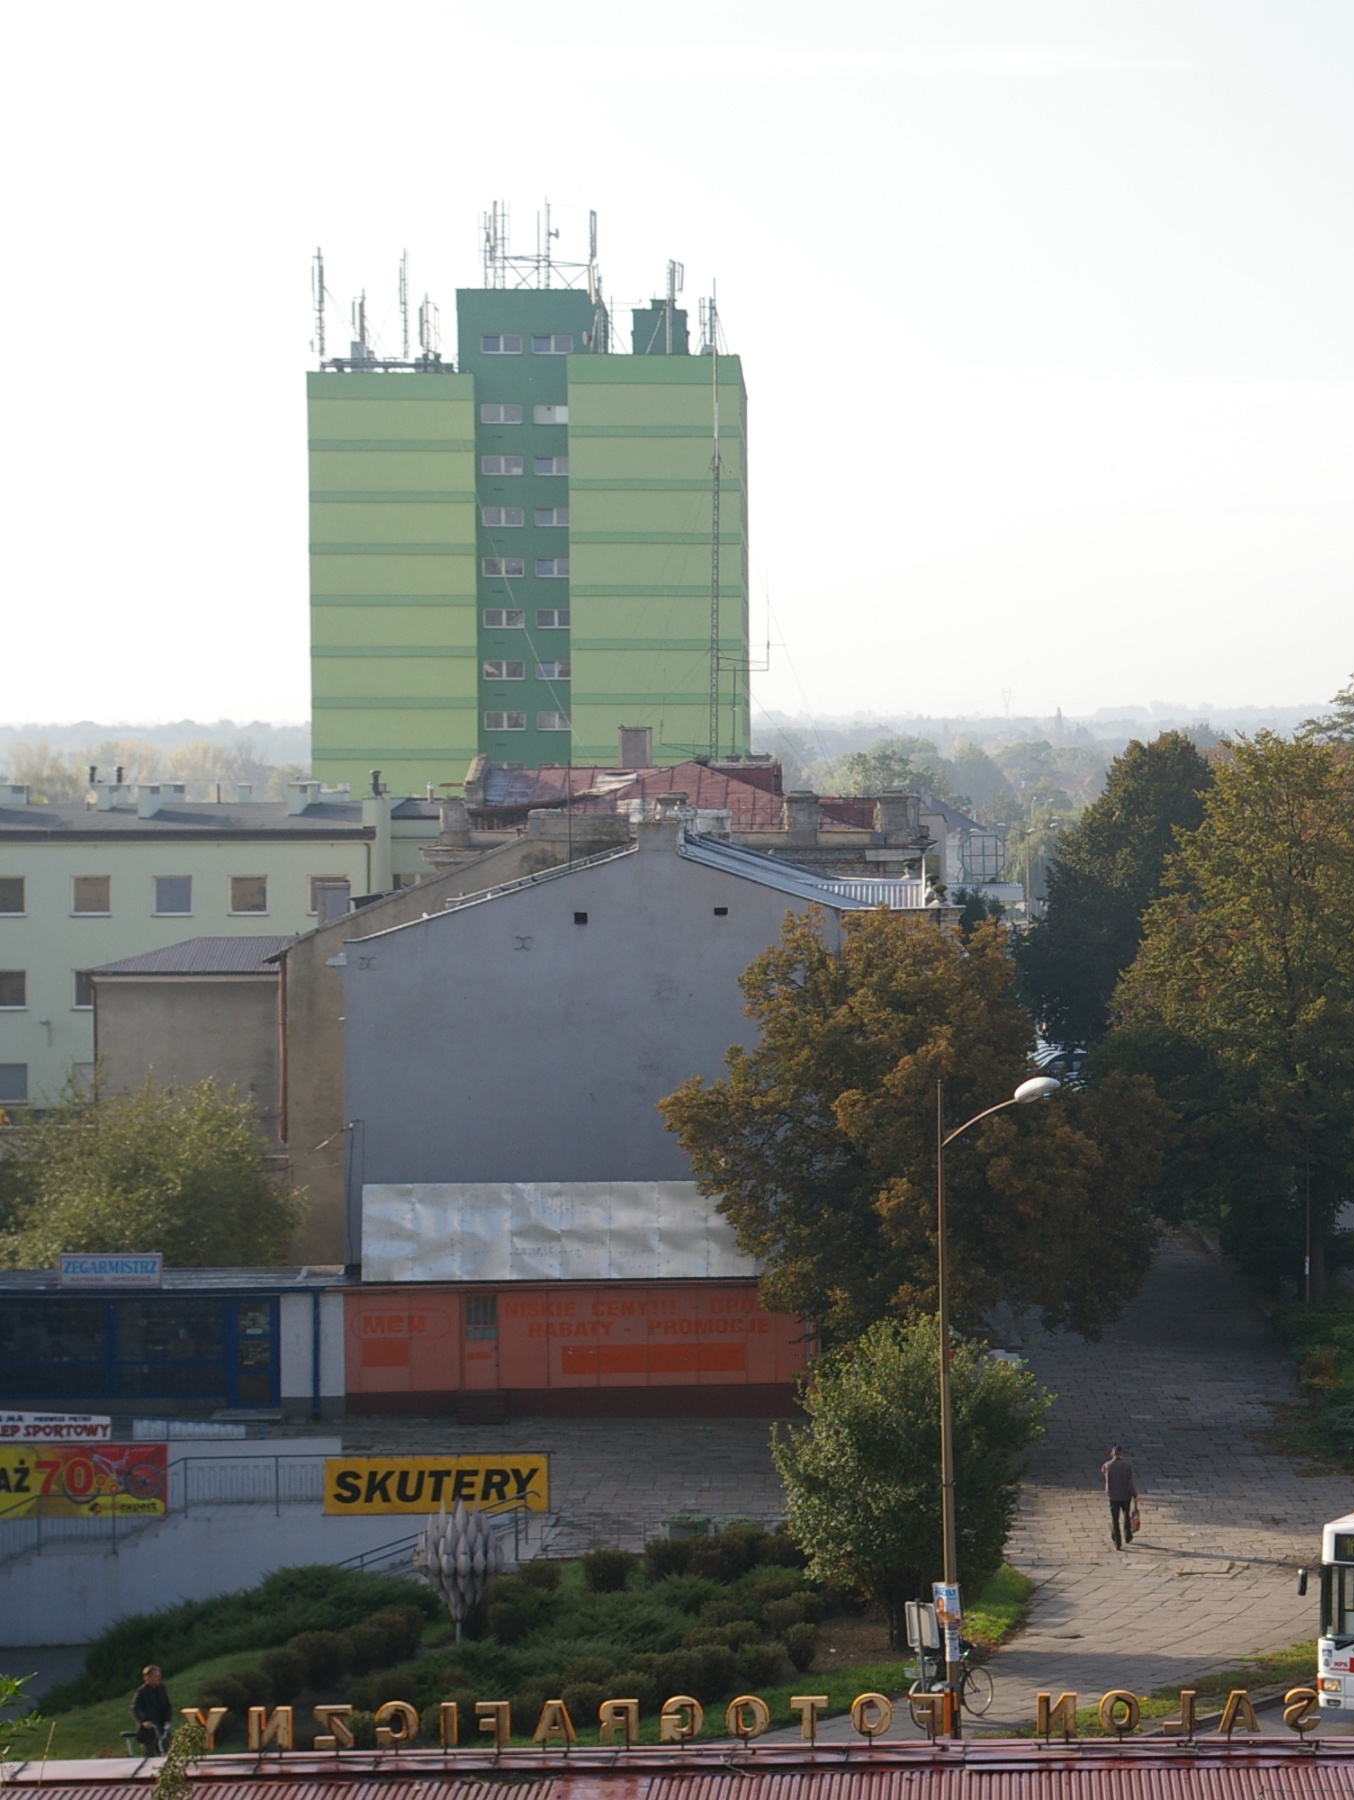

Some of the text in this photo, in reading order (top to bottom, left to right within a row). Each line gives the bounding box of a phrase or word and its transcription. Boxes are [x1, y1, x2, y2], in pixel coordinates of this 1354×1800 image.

[63, 1259, 157, 1275] ZEGARMISTRZ
[527, 1320, 614, 1338] RABATY
[647, 1317, 770, 1336] PROMOCJE
[24, 1423, 110, 1438] SPORTOWY
[332, 1467, 540, 1504] SKUTERY
